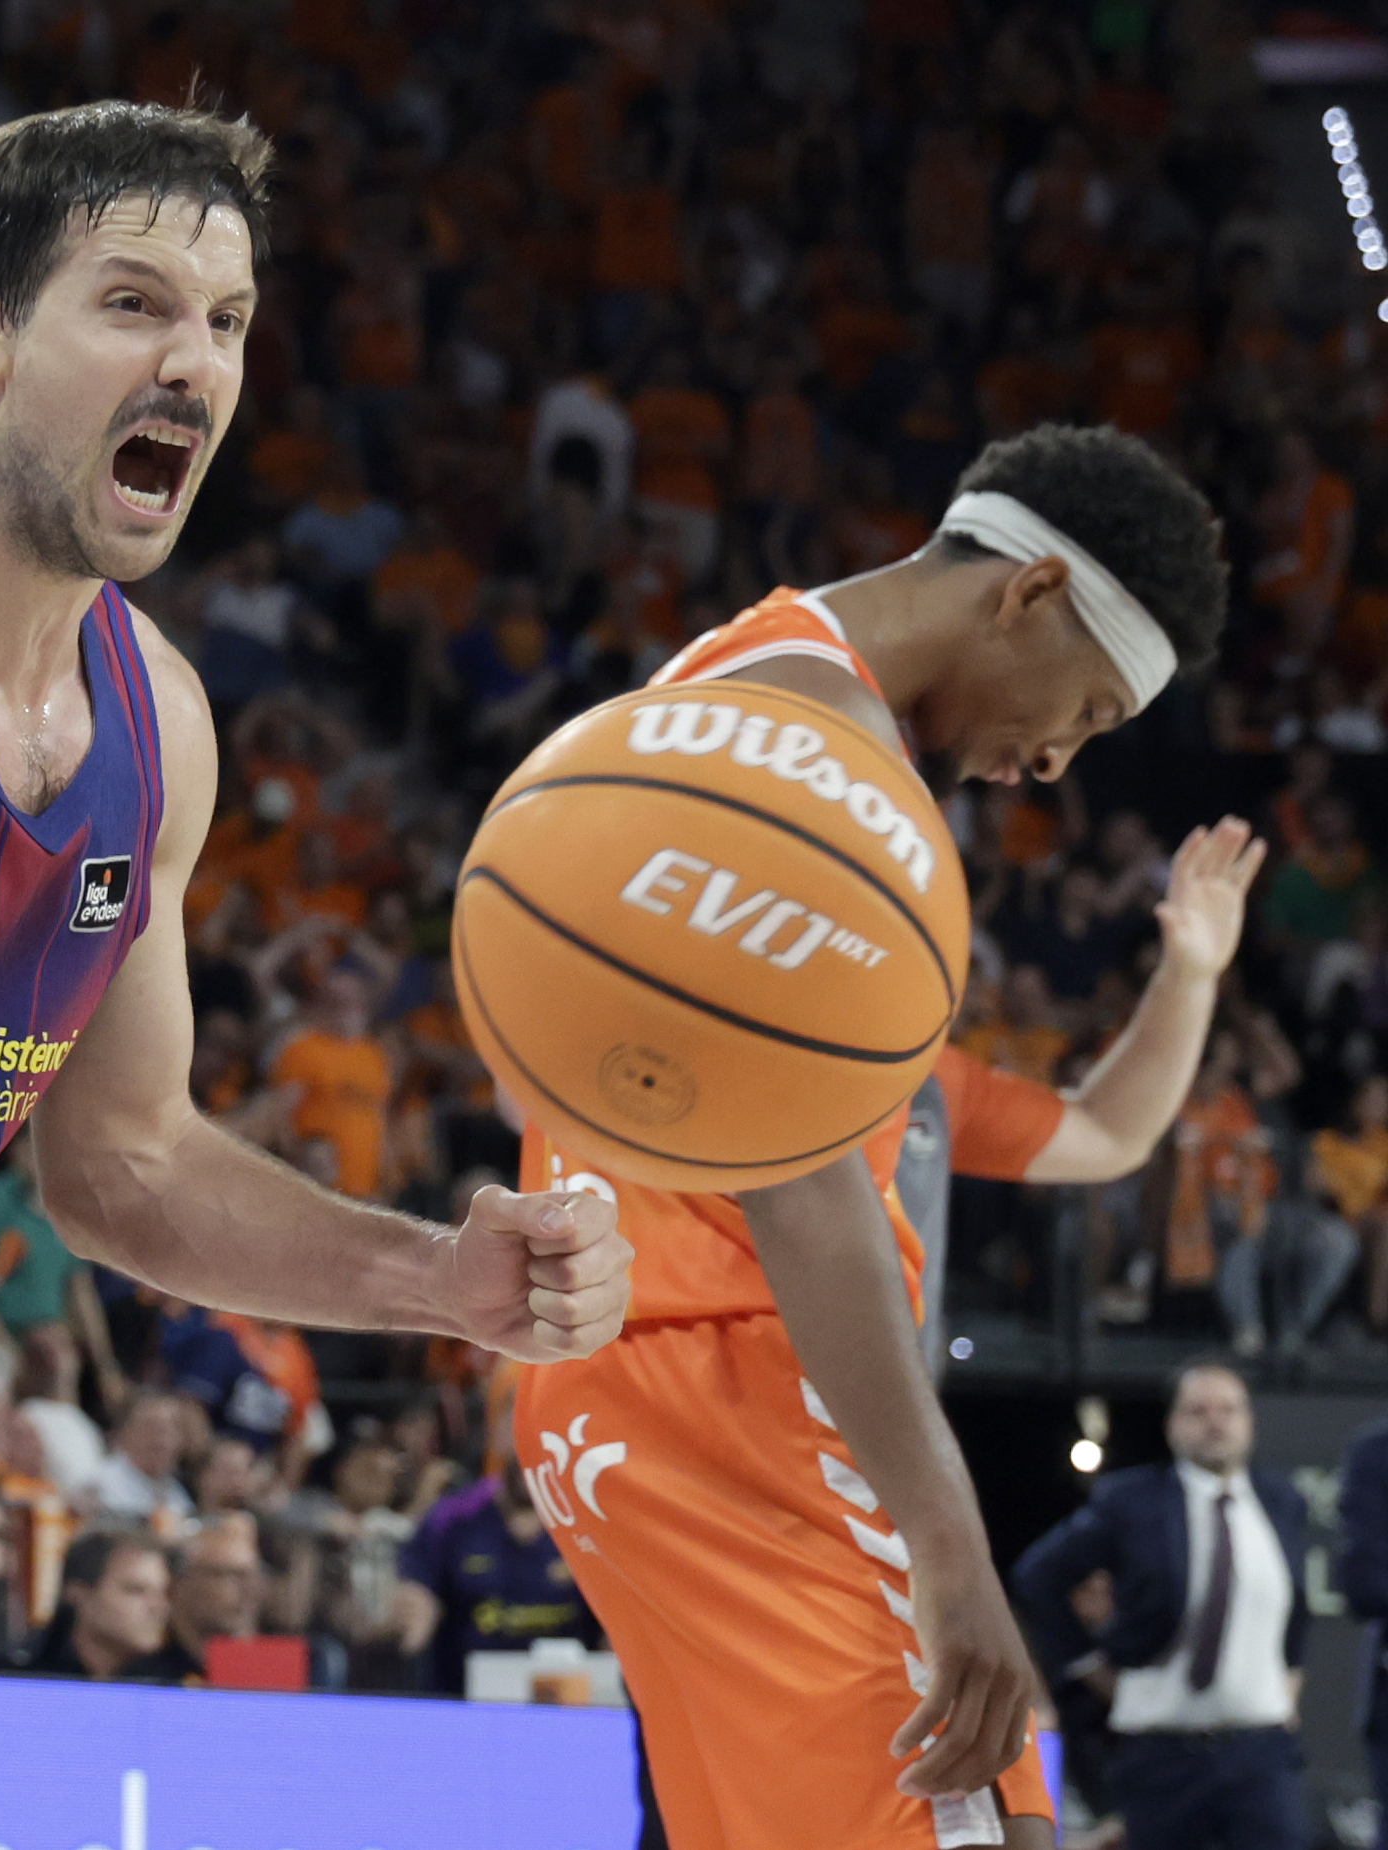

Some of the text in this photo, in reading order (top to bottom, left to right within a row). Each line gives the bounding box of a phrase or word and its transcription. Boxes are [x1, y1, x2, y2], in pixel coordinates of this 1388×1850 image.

[627, 702, 934, 895] Wilson
[86, 882, 108, 905] liga
[80, 901, 123, 922] endesa
